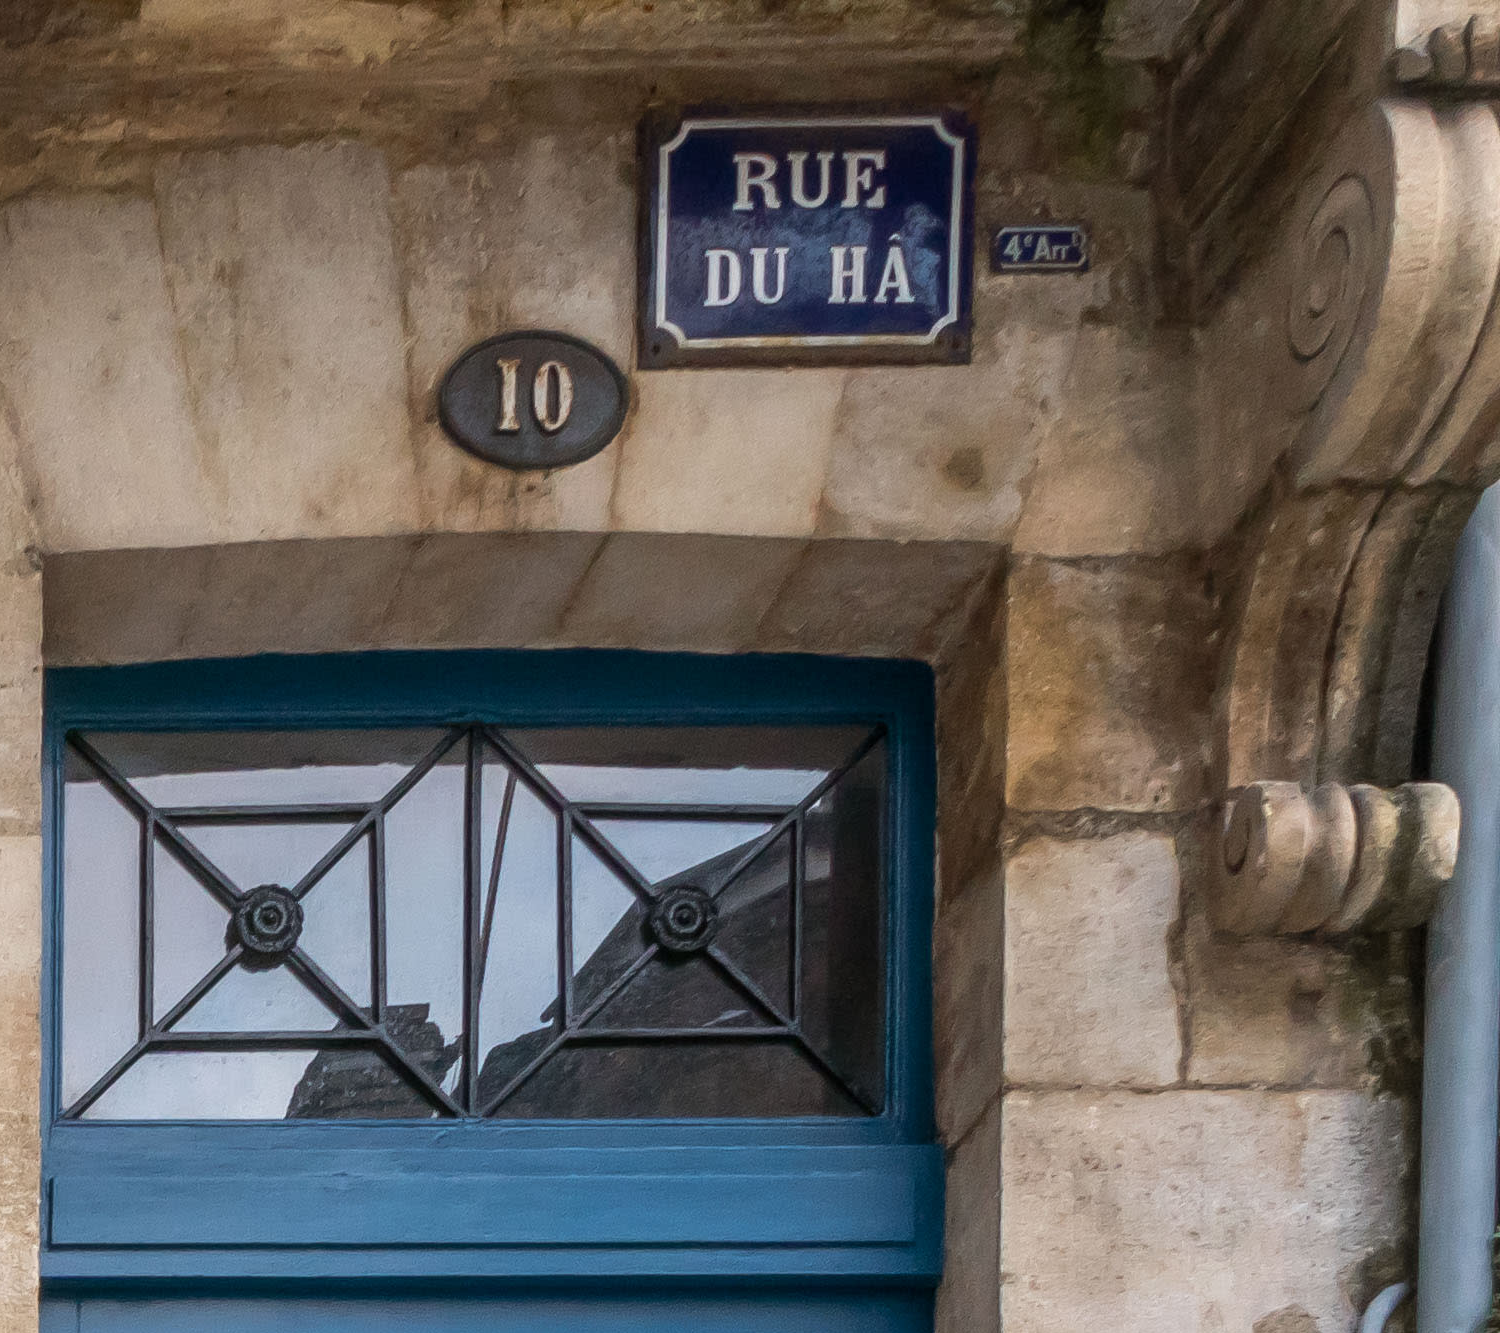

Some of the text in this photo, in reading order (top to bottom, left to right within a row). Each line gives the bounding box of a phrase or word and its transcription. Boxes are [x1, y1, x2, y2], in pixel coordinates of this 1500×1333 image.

[732, 149, 887, 211] RUE
[704, 233, 916, 307] DU HÂ
[496, 357, 574, 432] 10
